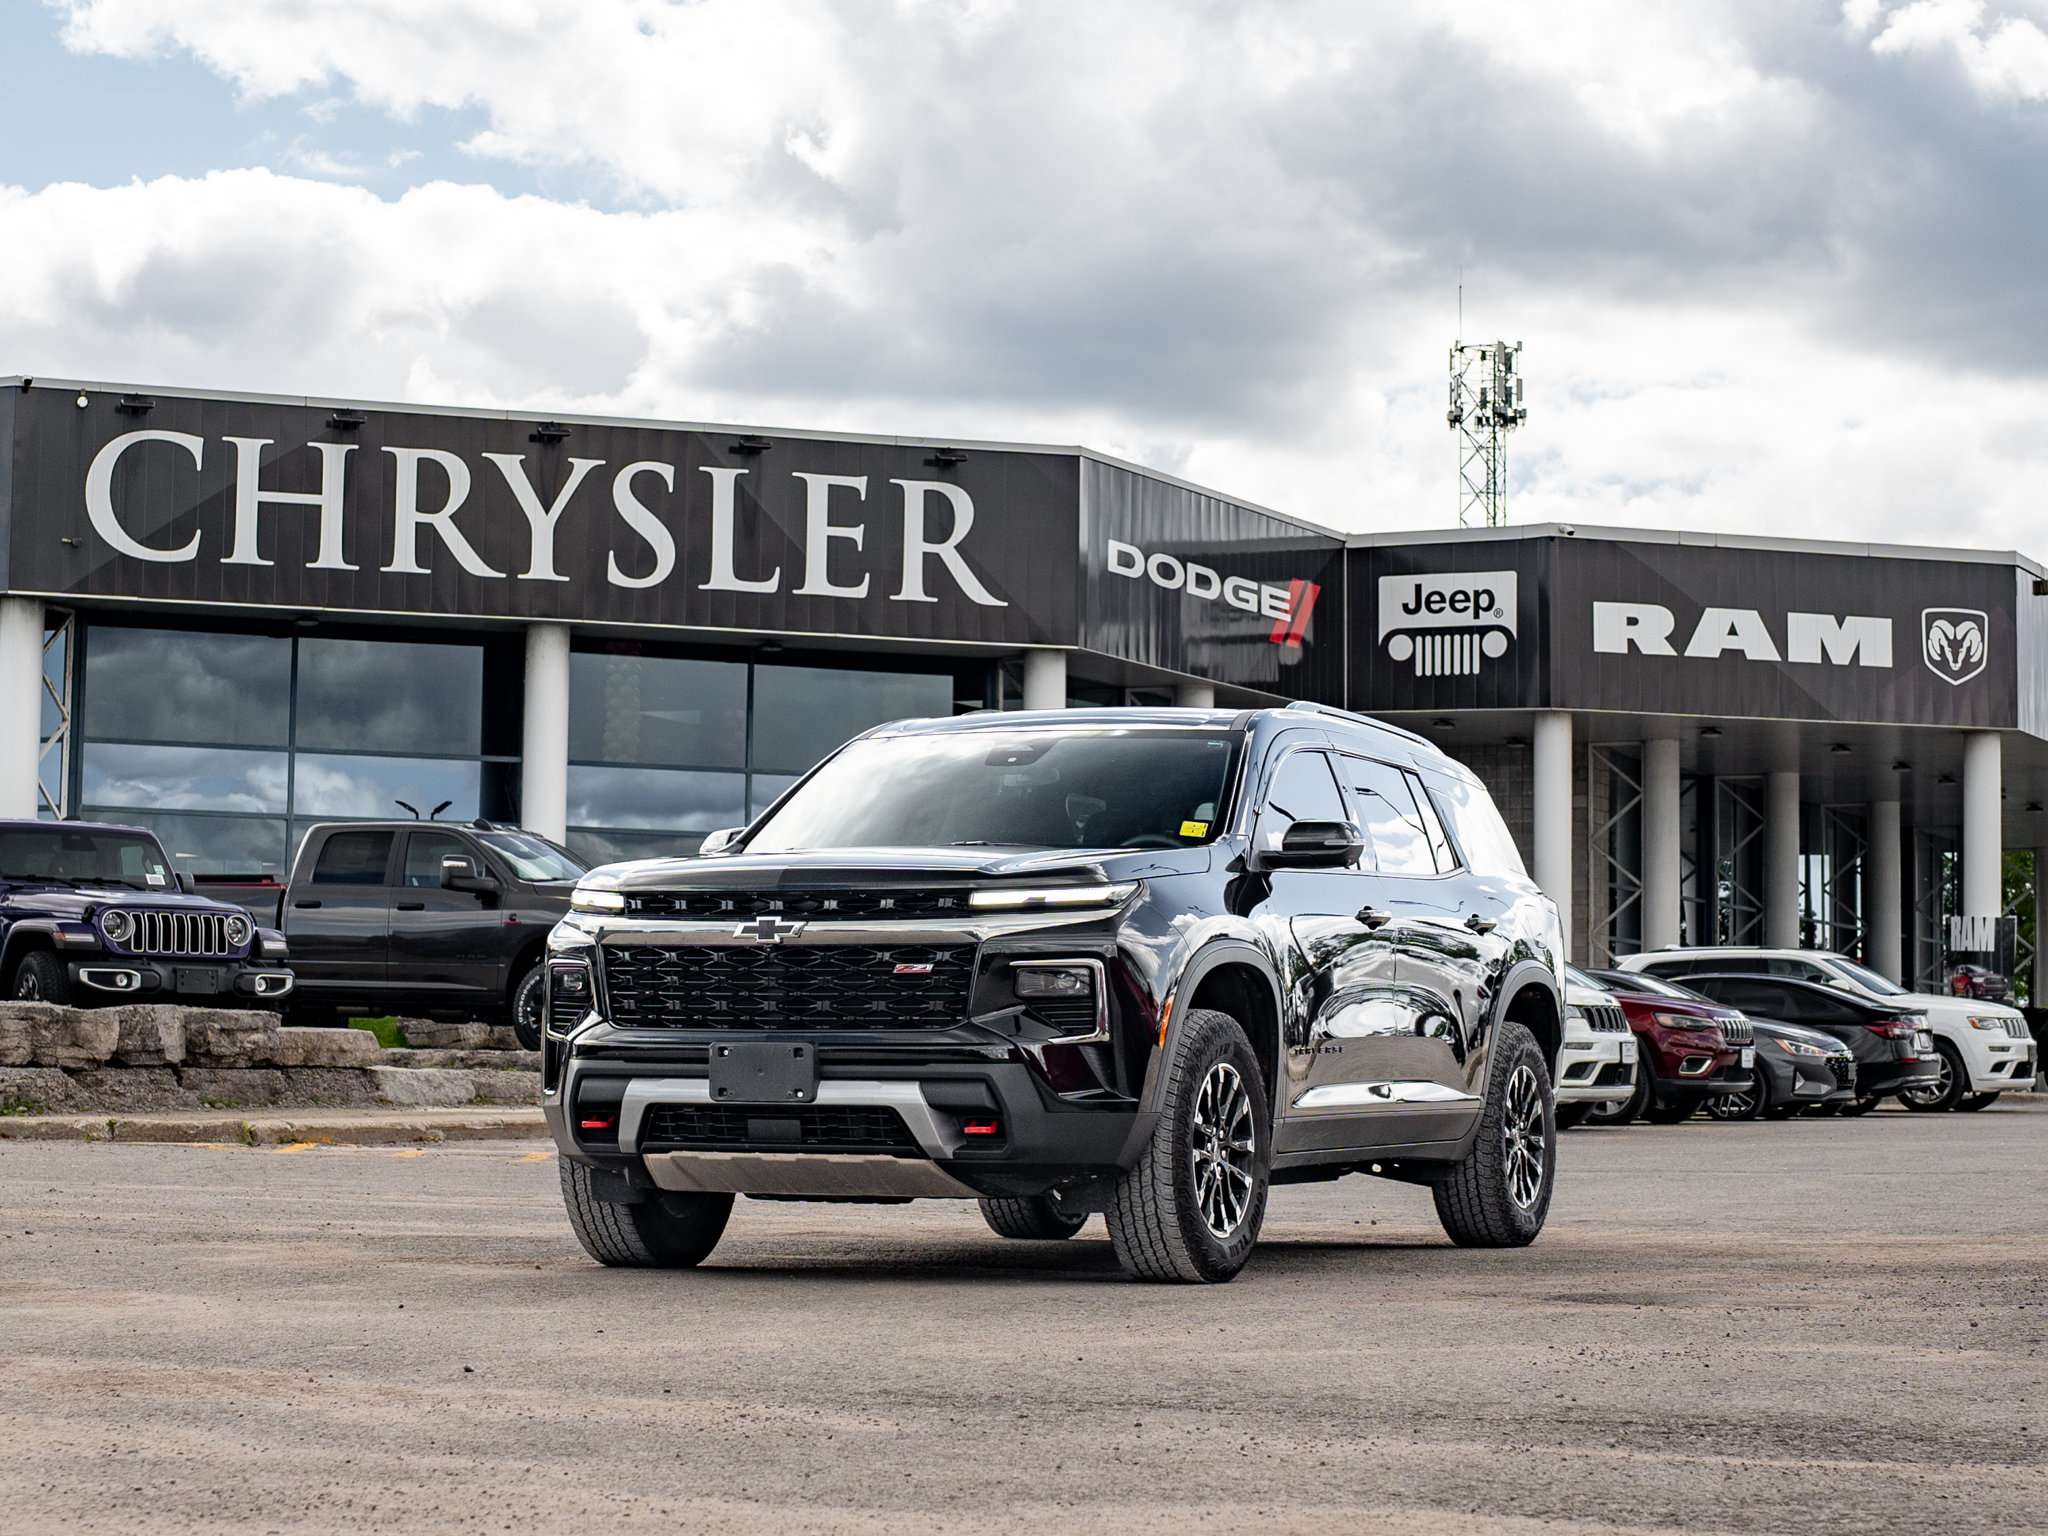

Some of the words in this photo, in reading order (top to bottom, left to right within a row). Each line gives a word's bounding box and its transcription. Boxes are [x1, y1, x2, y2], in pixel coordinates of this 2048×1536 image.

[85, 429, 1009, 607] CHRYSLER
[1107, 538, 1292, 623] DODGE
[1401, 583, 1496, 620] Jeep
[1593, 601, 1893, 668] RAM
[1950, 915, 1995, 952] RAM
